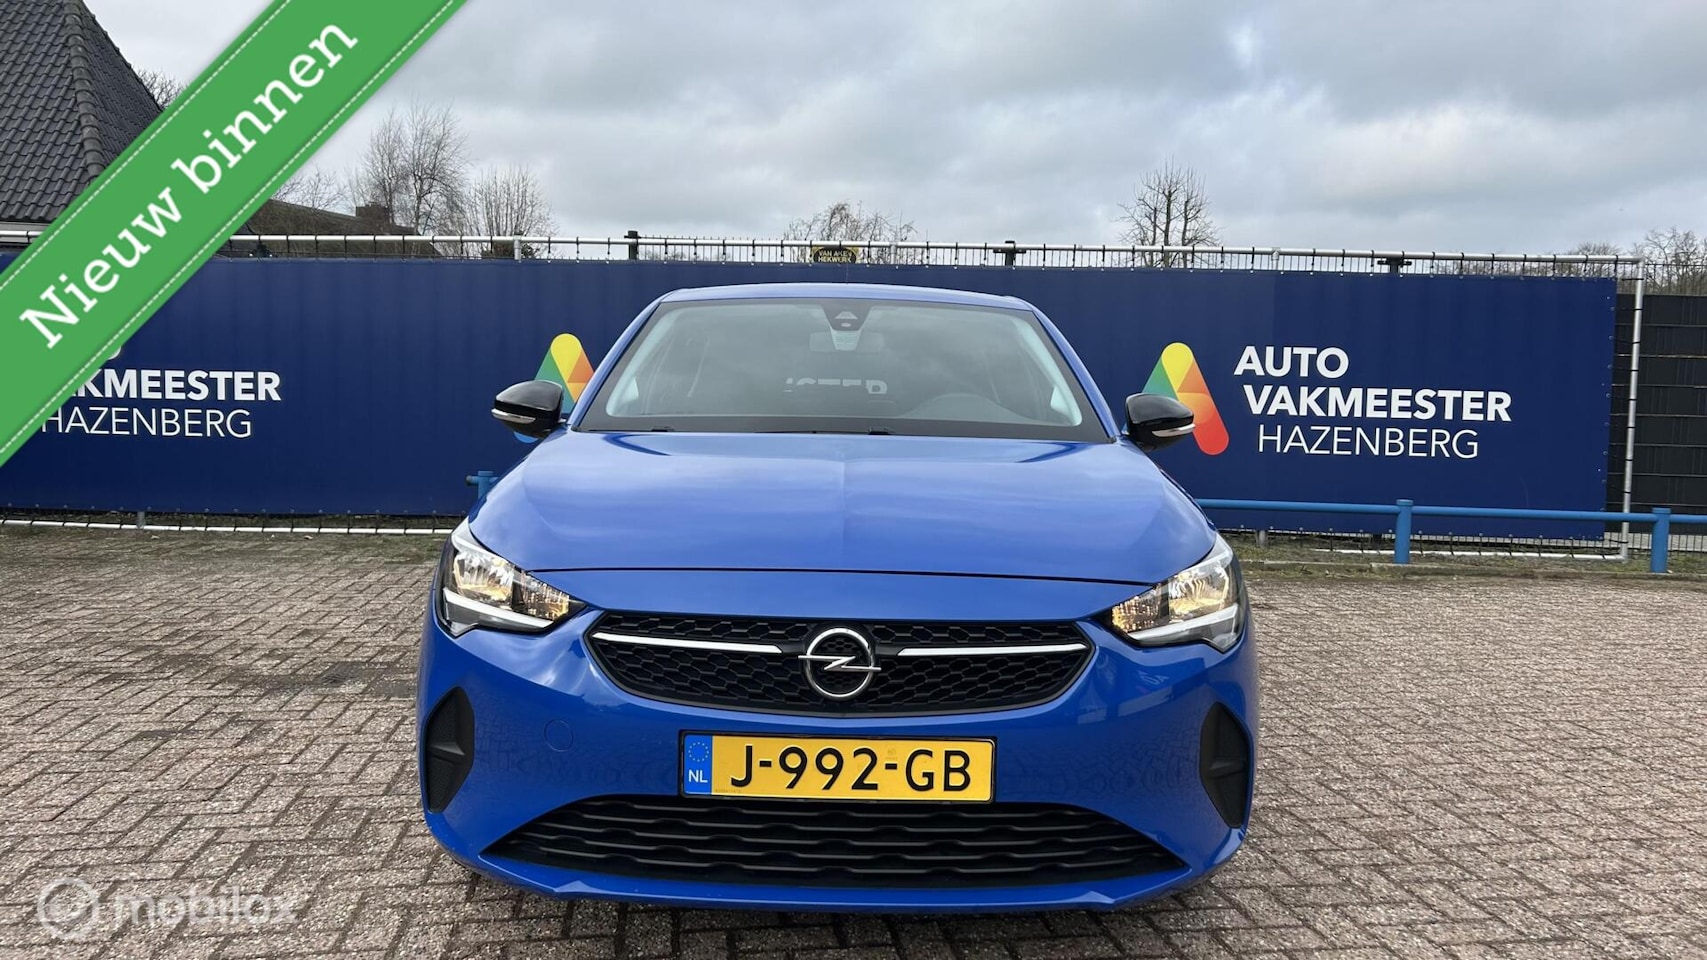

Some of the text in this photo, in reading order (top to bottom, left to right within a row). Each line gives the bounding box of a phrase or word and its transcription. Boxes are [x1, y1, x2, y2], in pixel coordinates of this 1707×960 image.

[1233, 346, 1349, 379] AUTO
[70, 368, 282, 401] KMEESTER
[1243, 384, 1513, 422] VAKMEESTER
[41, 406, 252, 438] HAZENBERG
[1258, 424, 1479, 459] HAZENBERG
[688, 769, 708, 783] NL
[730, 745, 971, 792] J-992-GB
